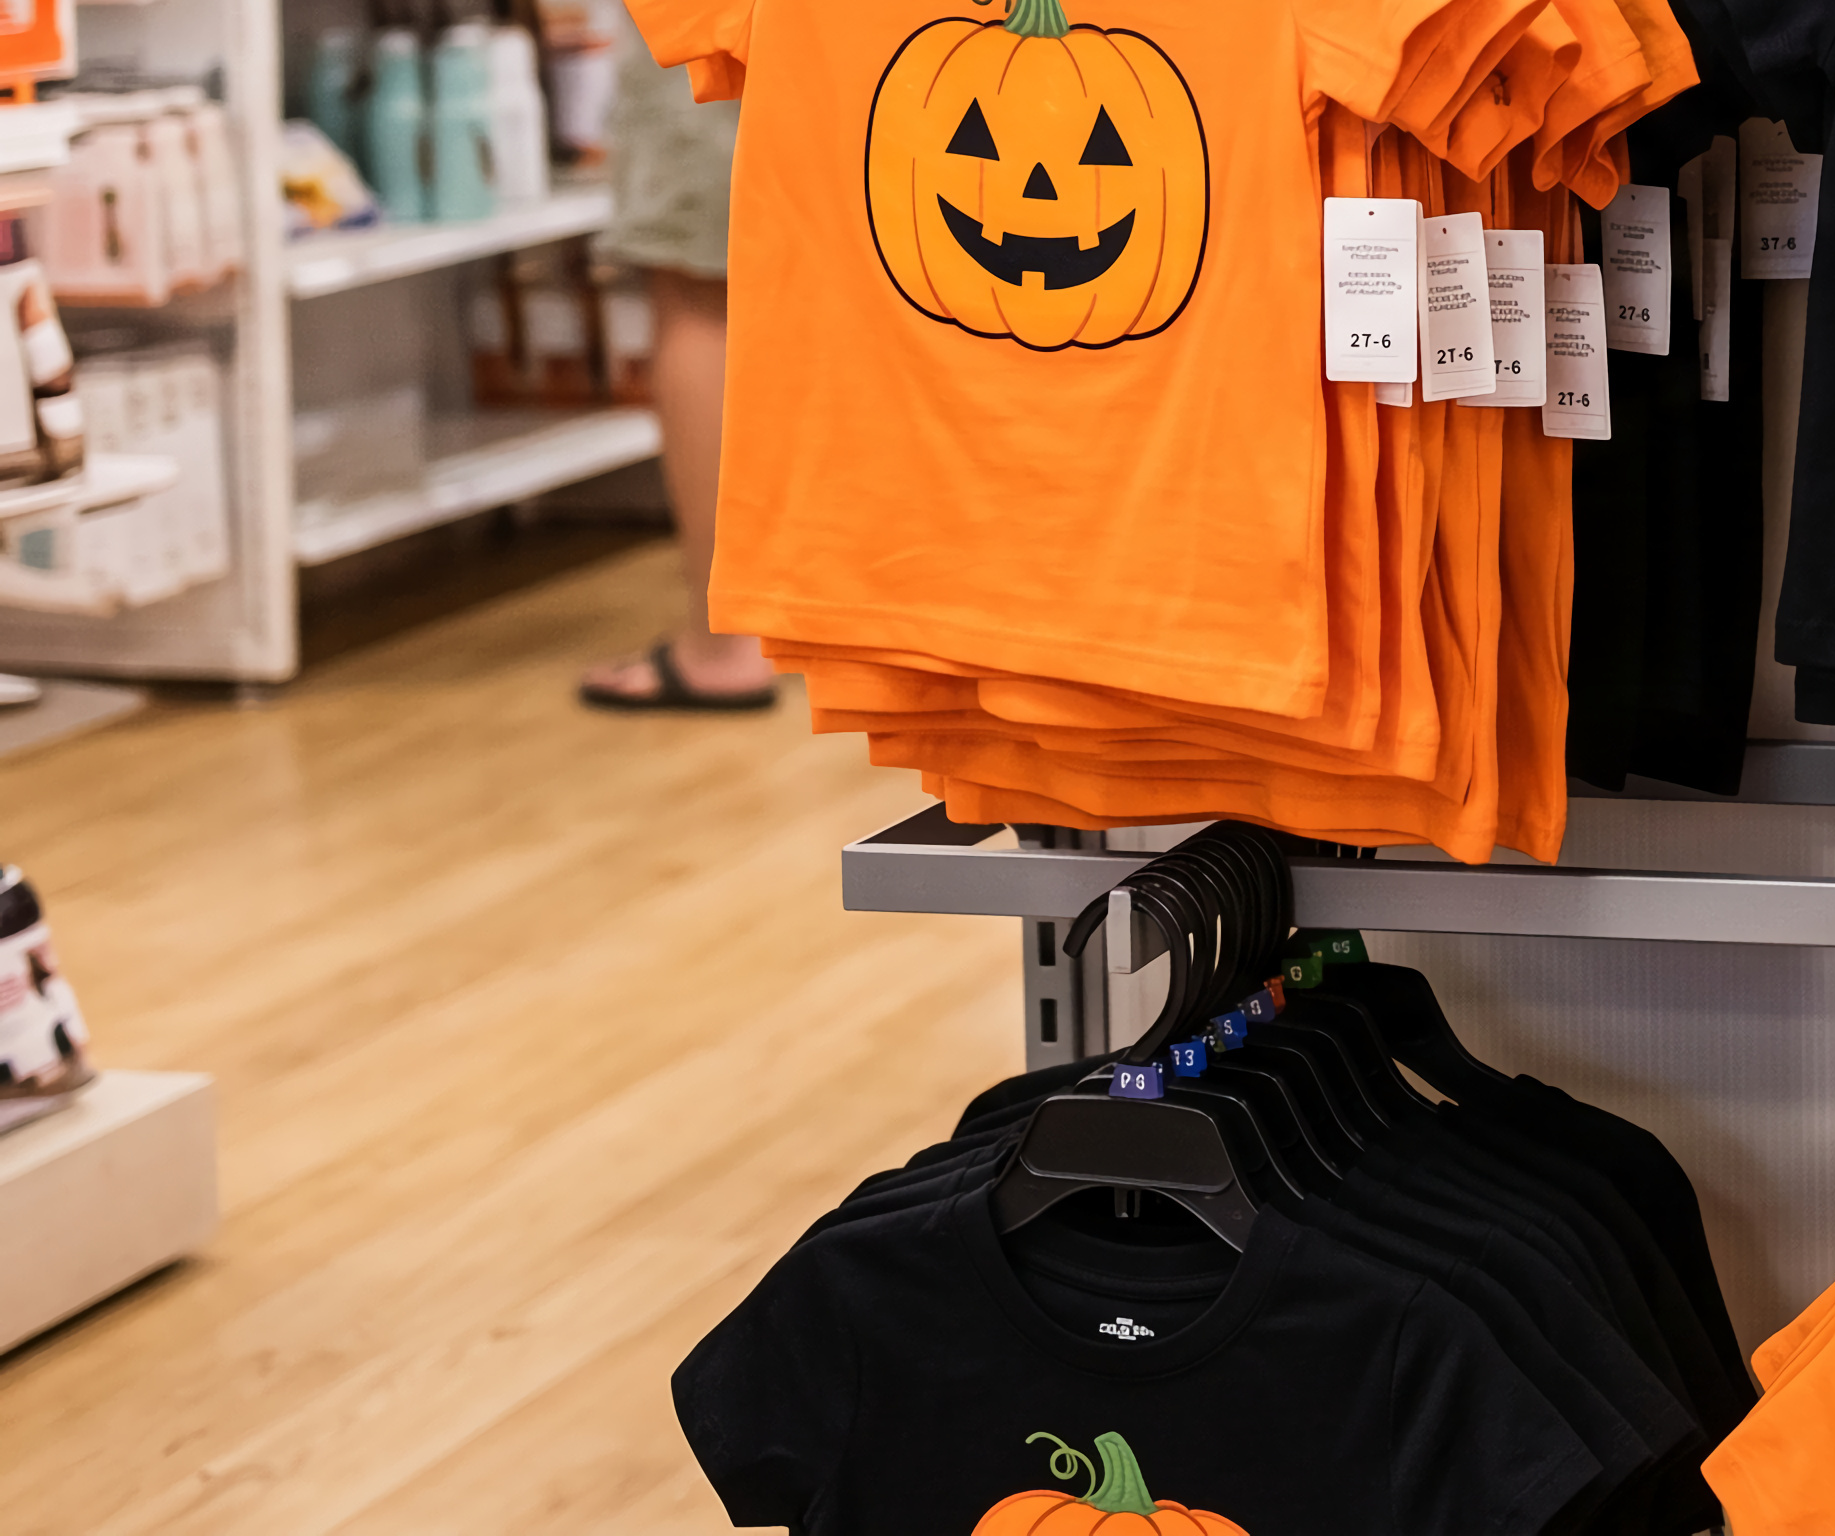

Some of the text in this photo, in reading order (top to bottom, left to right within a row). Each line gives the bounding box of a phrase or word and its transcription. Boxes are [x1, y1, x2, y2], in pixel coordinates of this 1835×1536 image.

[1437, 347, 1474, 365] 2T-6
[1494, 359, 1522, 375] T-6
[1557, 391, 1590, 408] 2T-6
